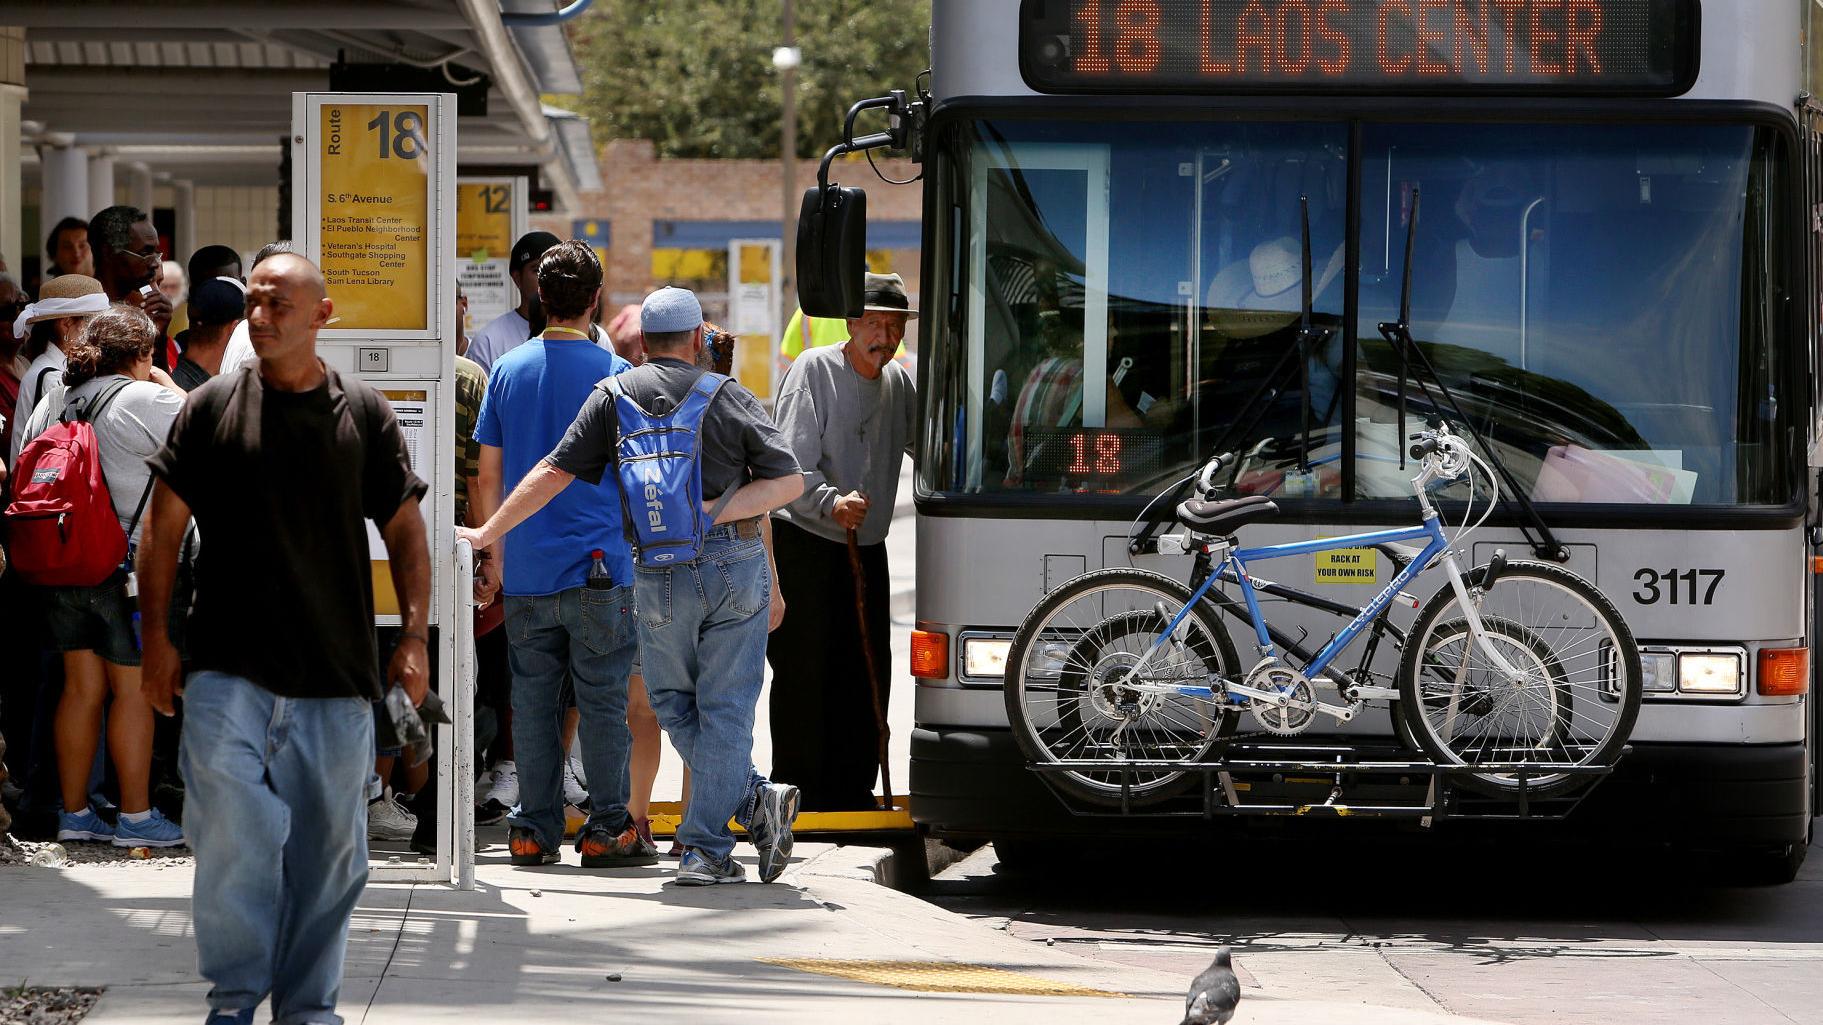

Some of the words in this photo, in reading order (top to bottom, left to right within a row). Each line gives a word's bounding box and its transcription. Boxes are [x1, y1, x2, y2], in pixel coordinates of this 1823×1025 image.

[1074, 0, 1160, 72] 18
[1200, 0, 1350, 72] LAOS
[1377, 0, 1602, 73] CENTER
[327, 109, 341, 155] Route
[367, 110, 423, 160] 18
[328, 194, 337, 203] S.
[352, 194, 392, 204] Avenue
[479, 186, 510, 213] 12
[337, 225, 363, 233] Pueblo
[365, 226, 421, 235] Neighborhood
[327, 242, 362, 250] Veteran's
[365, 243, 397, 251] Hospital
[327, 251, 366, 260] Southgate
[368, 252, 406, 260] Shopping
[379, 260, 405, 268] Center
[327, 277, 344, 285] Sam
[346, 277, 365, 285] Lena
[367, 278, 394, 286] Library
[368, 352, 380, 361] 18
[1068, 433, 1121, 474] 18
[1330, 555, 1351, 564] RACK
[1351, 555, 1361, 564] AT
[1317, 568, 1337, 577] YOUR
[1338, 568, 1356, 577] OWN
[1357, 568, 1375, 577] RISK
[1632, 567, 1725, 605] 3117
